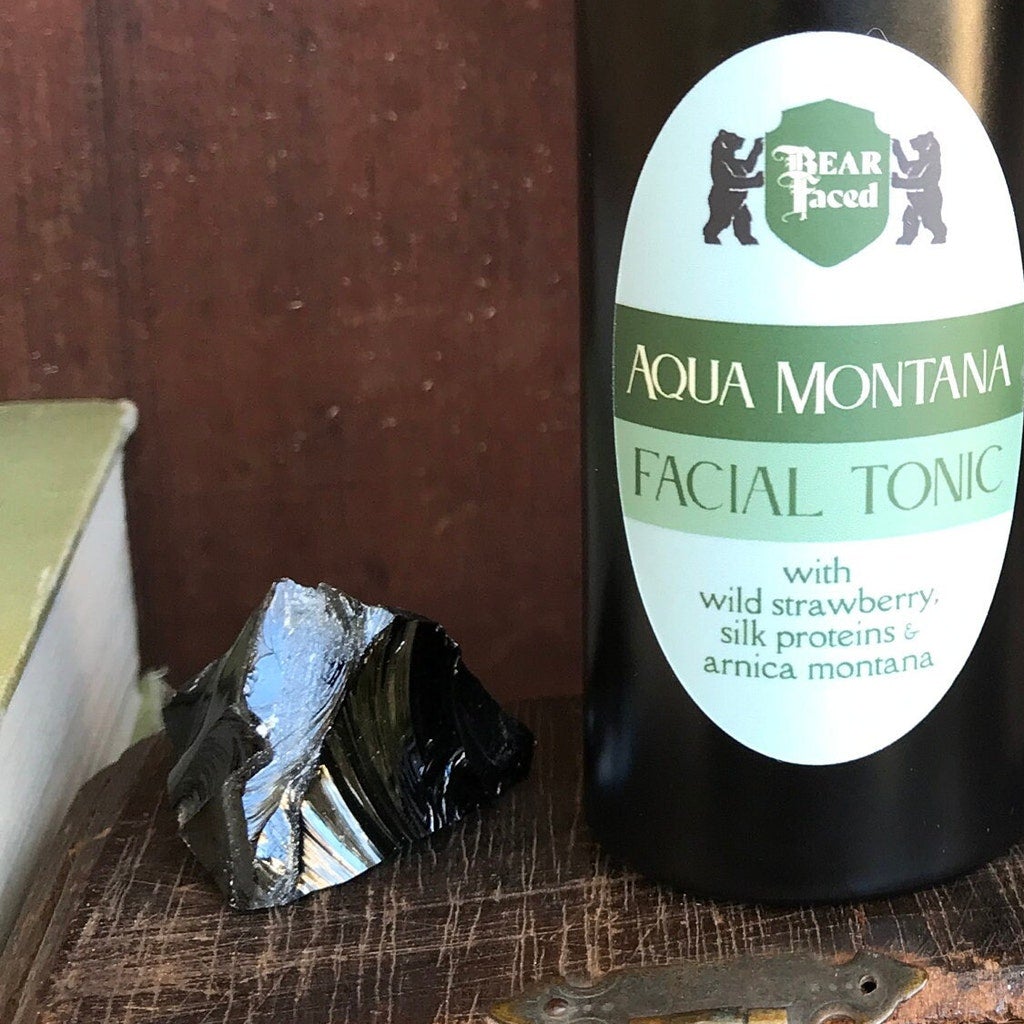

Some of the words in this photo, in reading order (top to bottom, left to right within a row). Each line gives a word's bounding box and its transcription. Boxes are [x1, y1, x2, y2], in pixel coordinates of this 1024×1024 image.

[771, 144, 882, 175] BEAR
[777, 170, 879, 222] Faced
[626, 344, 755, 409] AQUA
[777, 344, 1012, 414] MONTANA
[634, 447, 823, 517] FACIAL
[851, 444, 1003, 515] TONIC
[783, 556, 851, 584] with
[700, 586, 762, 614] wild
[772, 587, 939, 617] strawberry,
[721, 618, 766, 646] silk
[777, 621, 895, 653] proteins
[904, 623, 919, 640] &
[704, 653, 797, 679] arnica
[808, 651, 935, 680] montana
